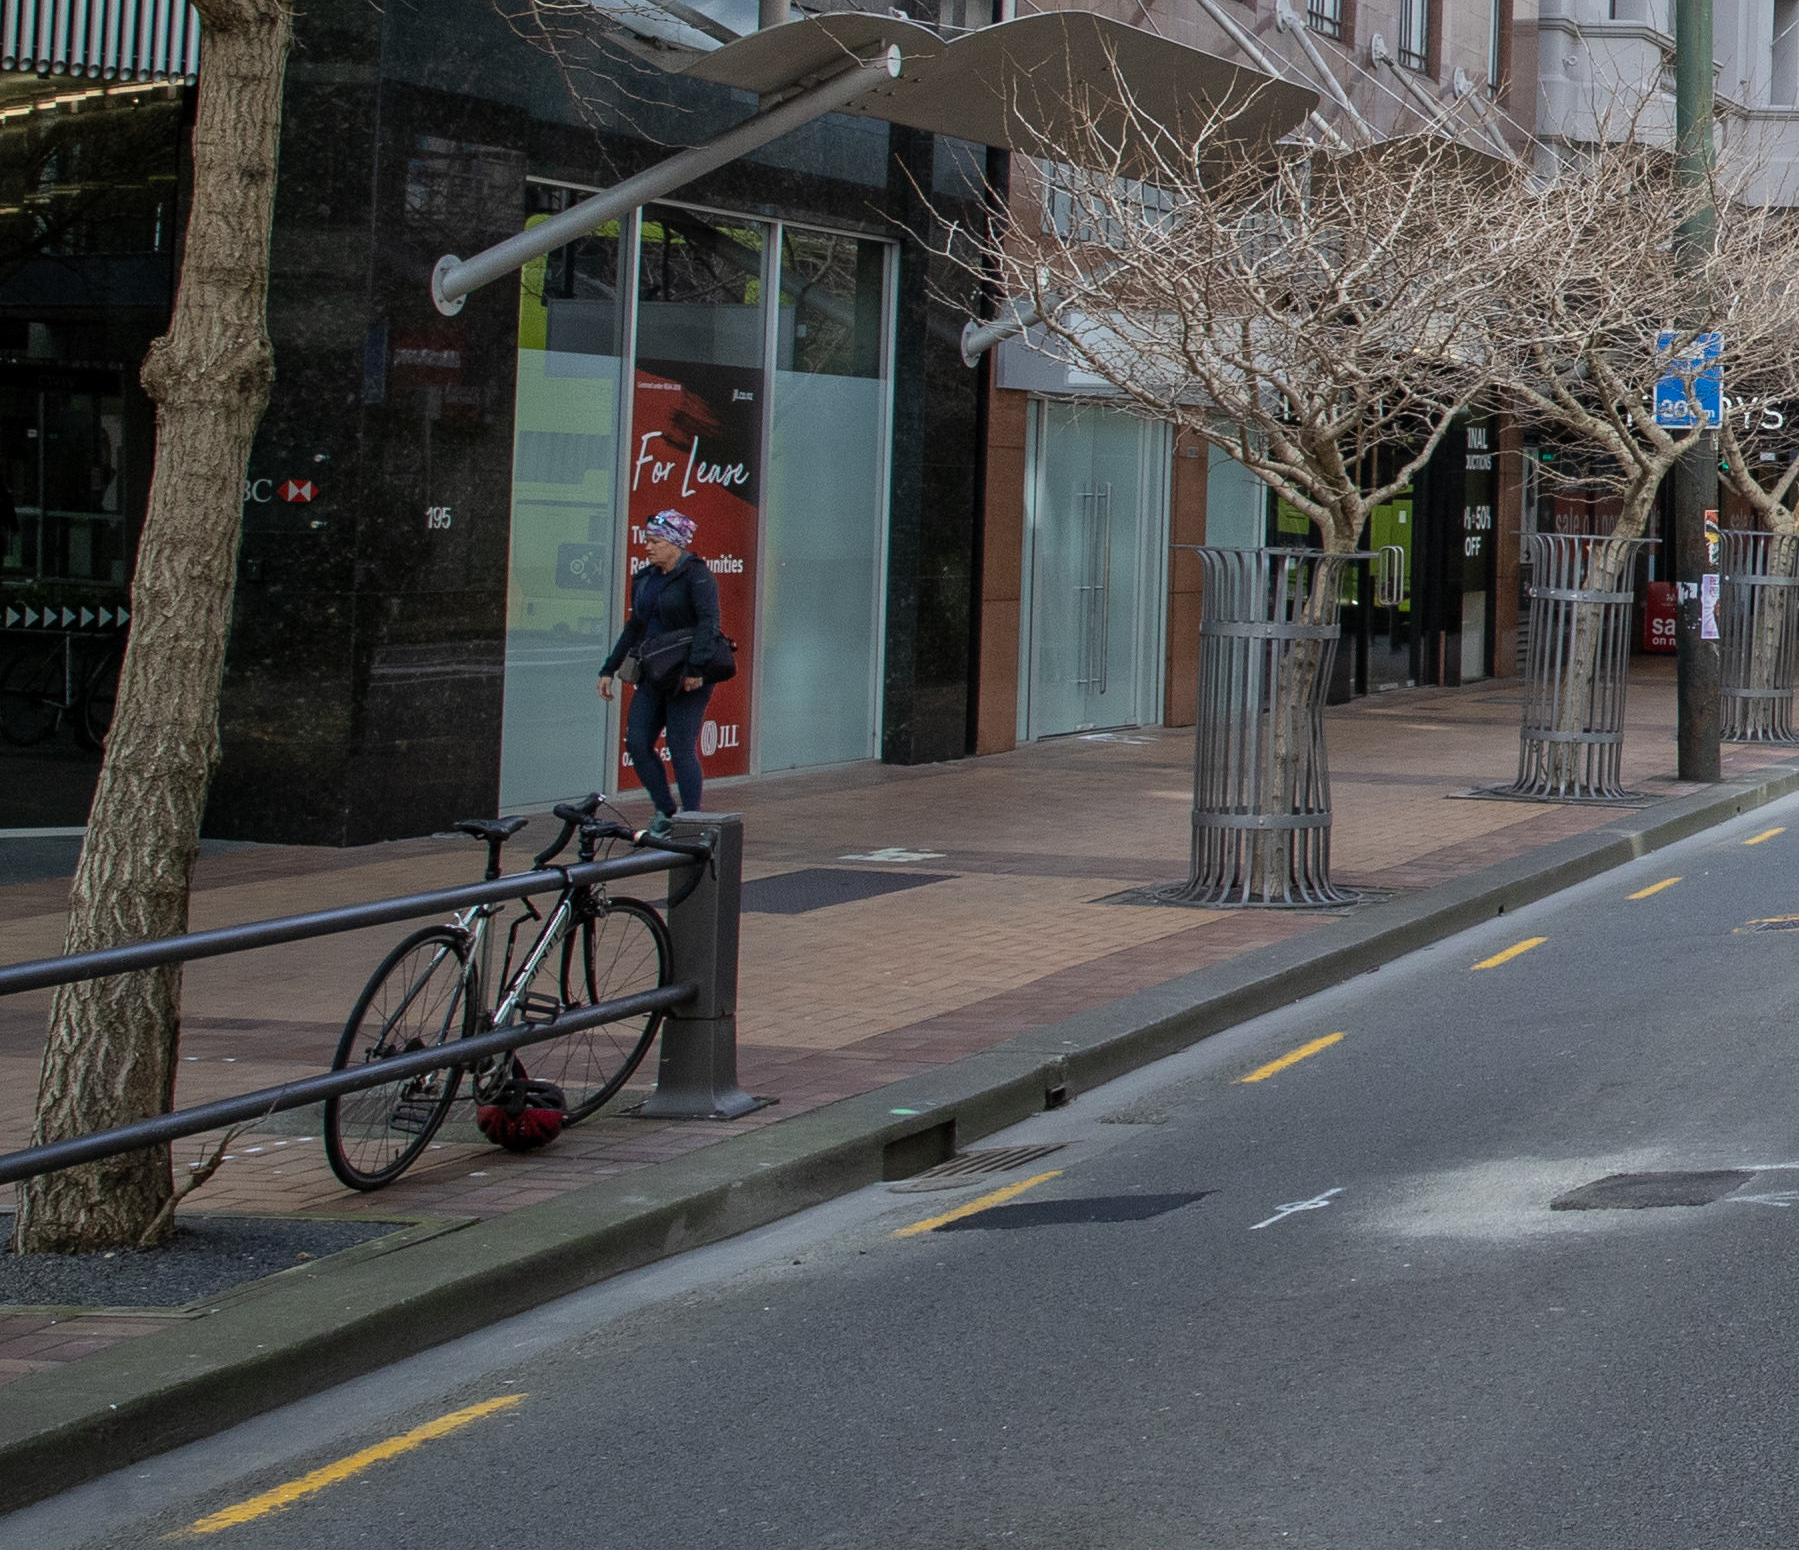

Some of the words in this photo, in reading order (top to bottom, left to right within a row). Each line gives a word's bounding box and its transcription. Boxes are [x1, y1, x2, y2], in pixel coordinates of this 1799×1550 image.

[632, 431, 676, 491] For
[681, 435, 750, 498] Lease
[426, 507, 452, 529] 195
[1465, 536, 1482, 557] OFF
[1652, 637, 1666, 646] on
[717, 724, 740, 748] JLL
